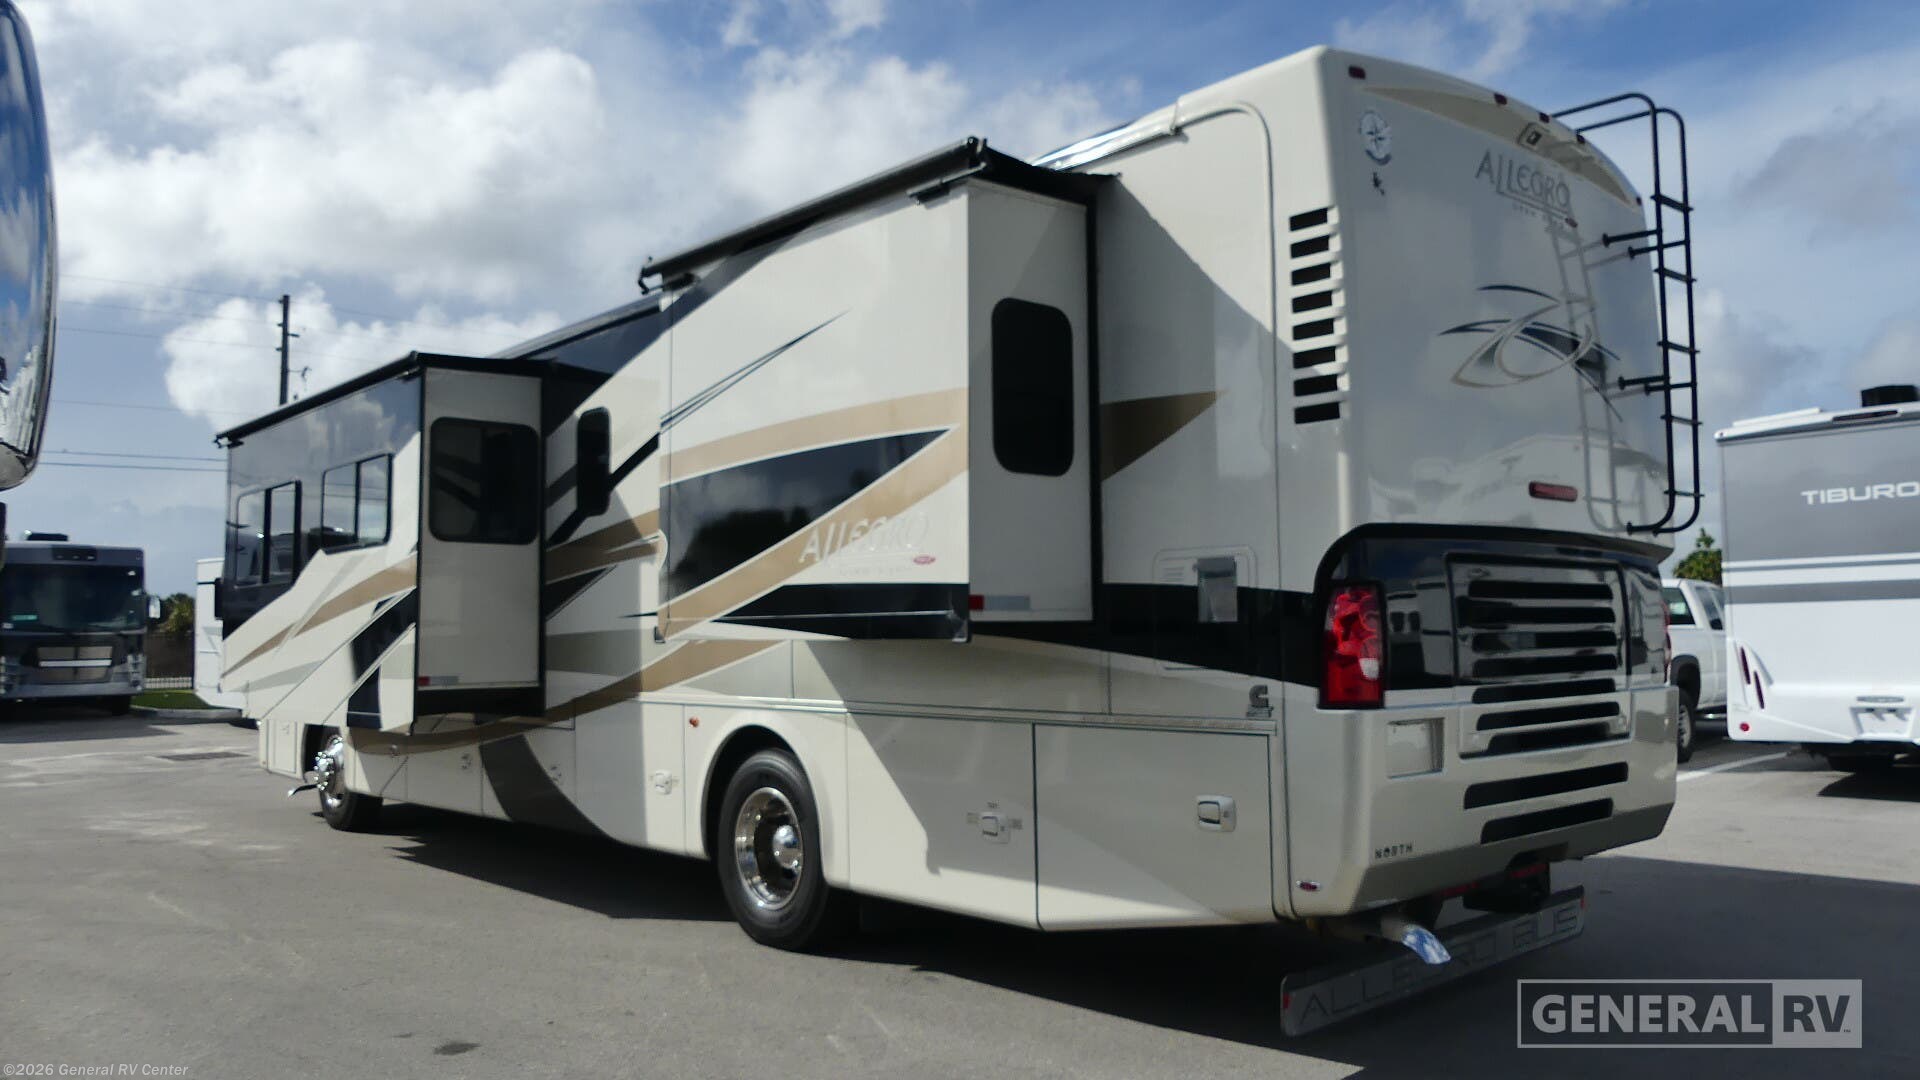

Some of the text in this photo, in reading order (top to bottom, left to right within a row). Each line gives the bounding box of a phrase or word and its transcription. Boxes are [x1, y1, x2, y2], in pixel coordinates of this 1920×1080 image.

[1475, 149, 1570, 212] ALLEGRO
[1801, 481, 1920, 505] TIBURO
[1512, 905, 1578, 948] BUS
